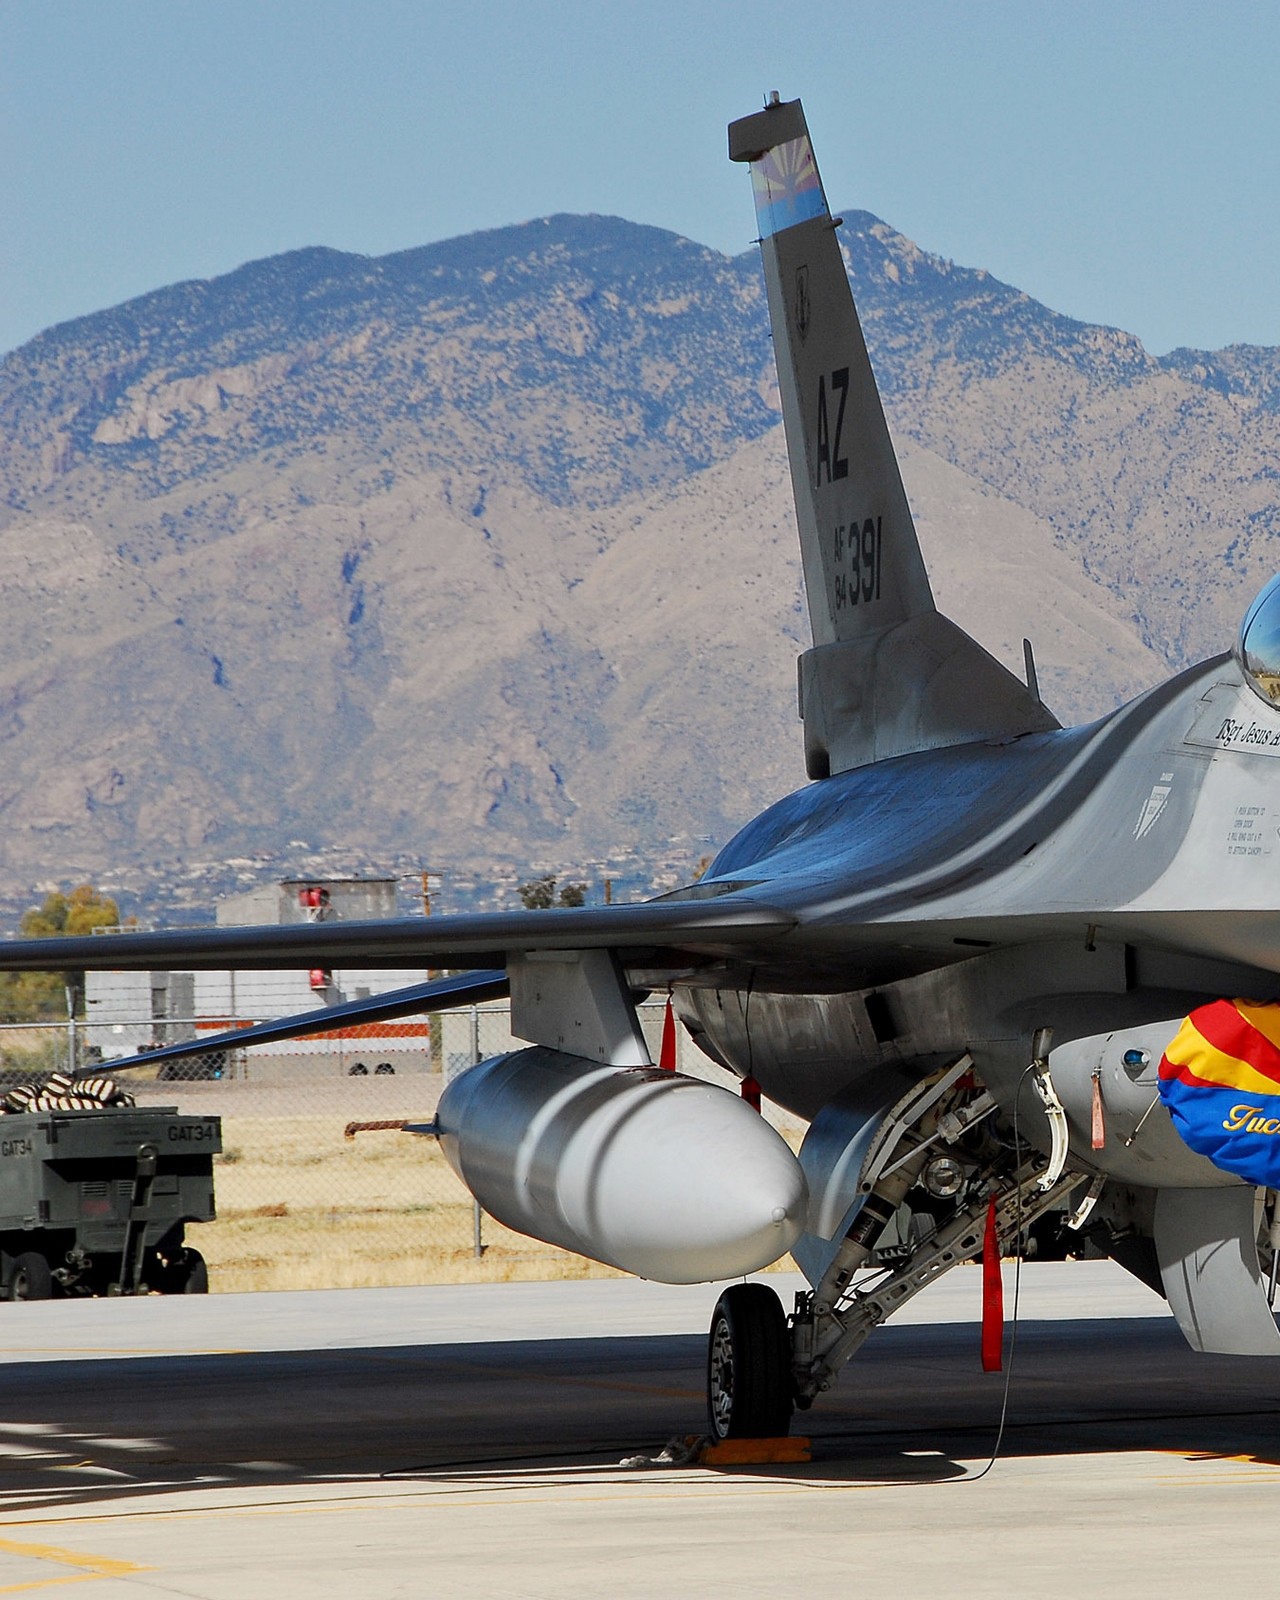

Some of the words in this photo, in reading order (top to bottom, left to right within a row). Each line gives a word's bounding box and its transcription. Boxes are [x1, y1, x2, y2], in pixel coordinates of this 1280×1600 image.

[817, 366, 849, 487] AZ
[834, 526, 845, 563] AF
[848, 516, 882, 606] 391
[835, 573, 846, 610] 84
[1215, 718, 1243, 747] TSgt
[1241, 721, 1272, 745] Jesus
[1, 1139, 33, 1157] GAT34
[168, 1125, 214, 1142] GAT34
